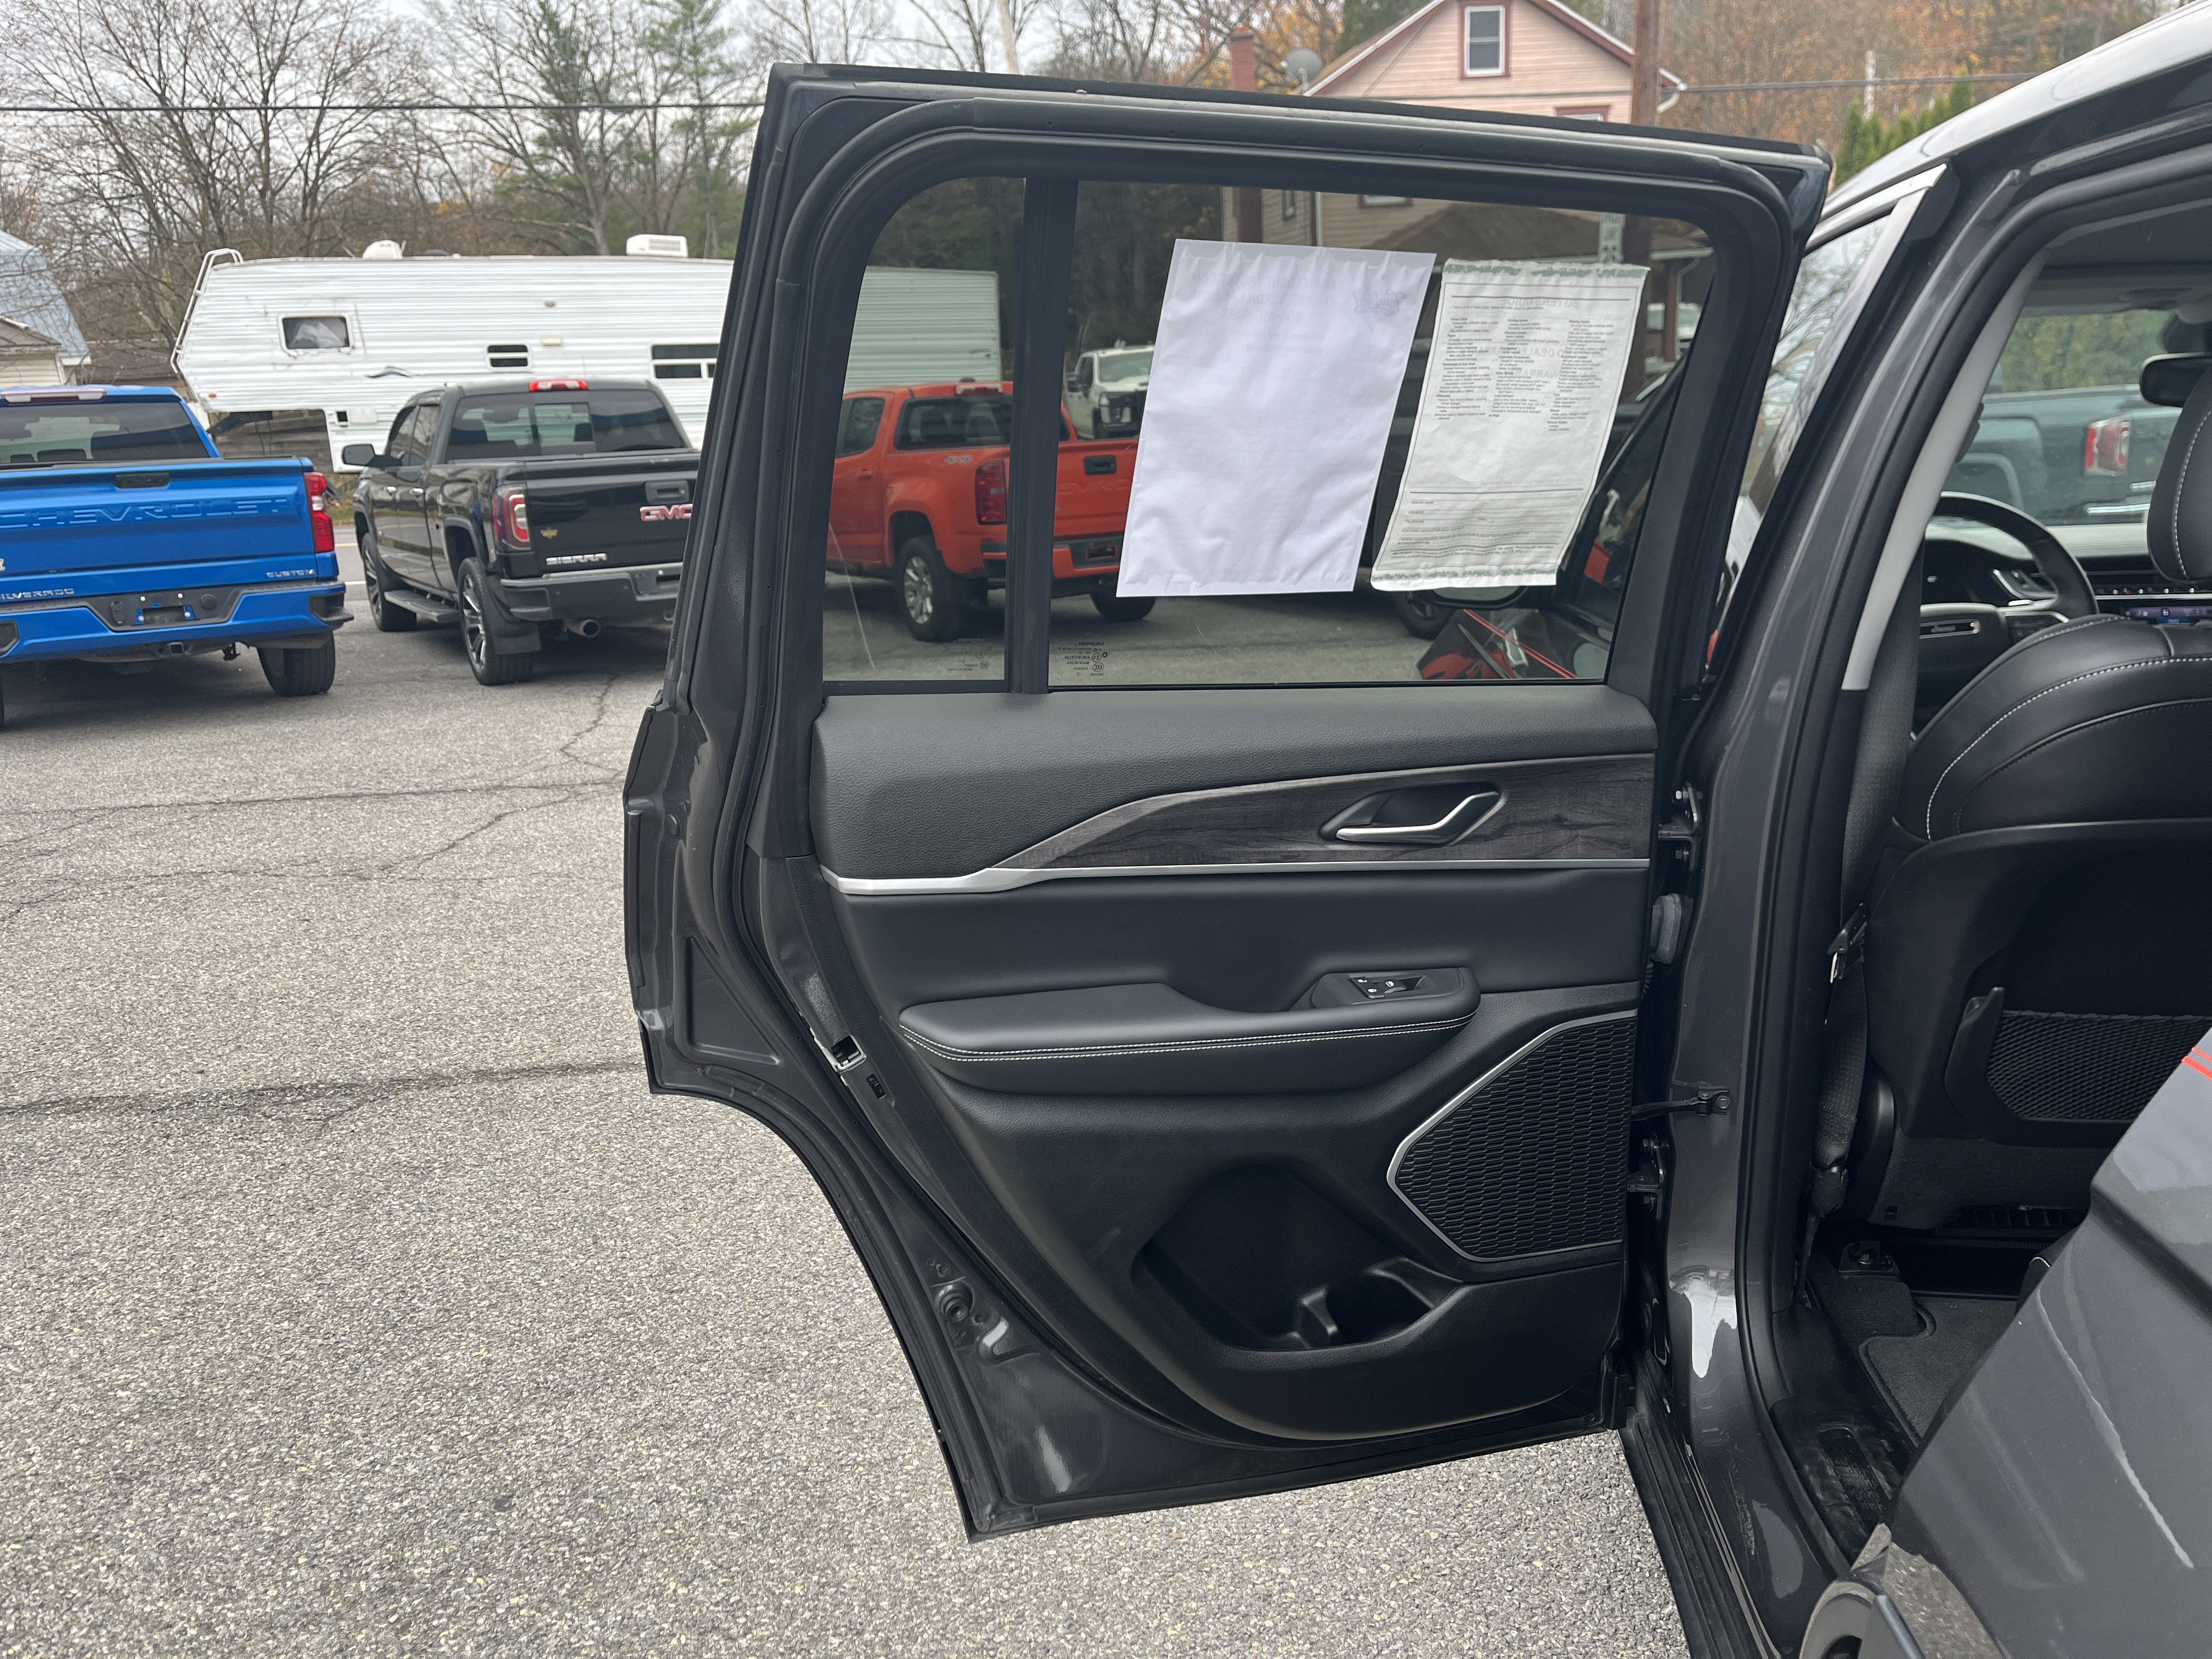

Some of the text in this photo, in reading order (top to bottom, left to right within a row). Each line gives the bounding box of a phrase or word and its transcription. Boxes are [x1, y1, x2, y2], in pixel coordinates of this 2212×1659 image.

[0, 498, 290, 529] CHEVROLET
[640, 504, 693, 522] GMC
[546, 553, 607, 566] SIERRA
[267, 569, 316, 578] CUSTOM
